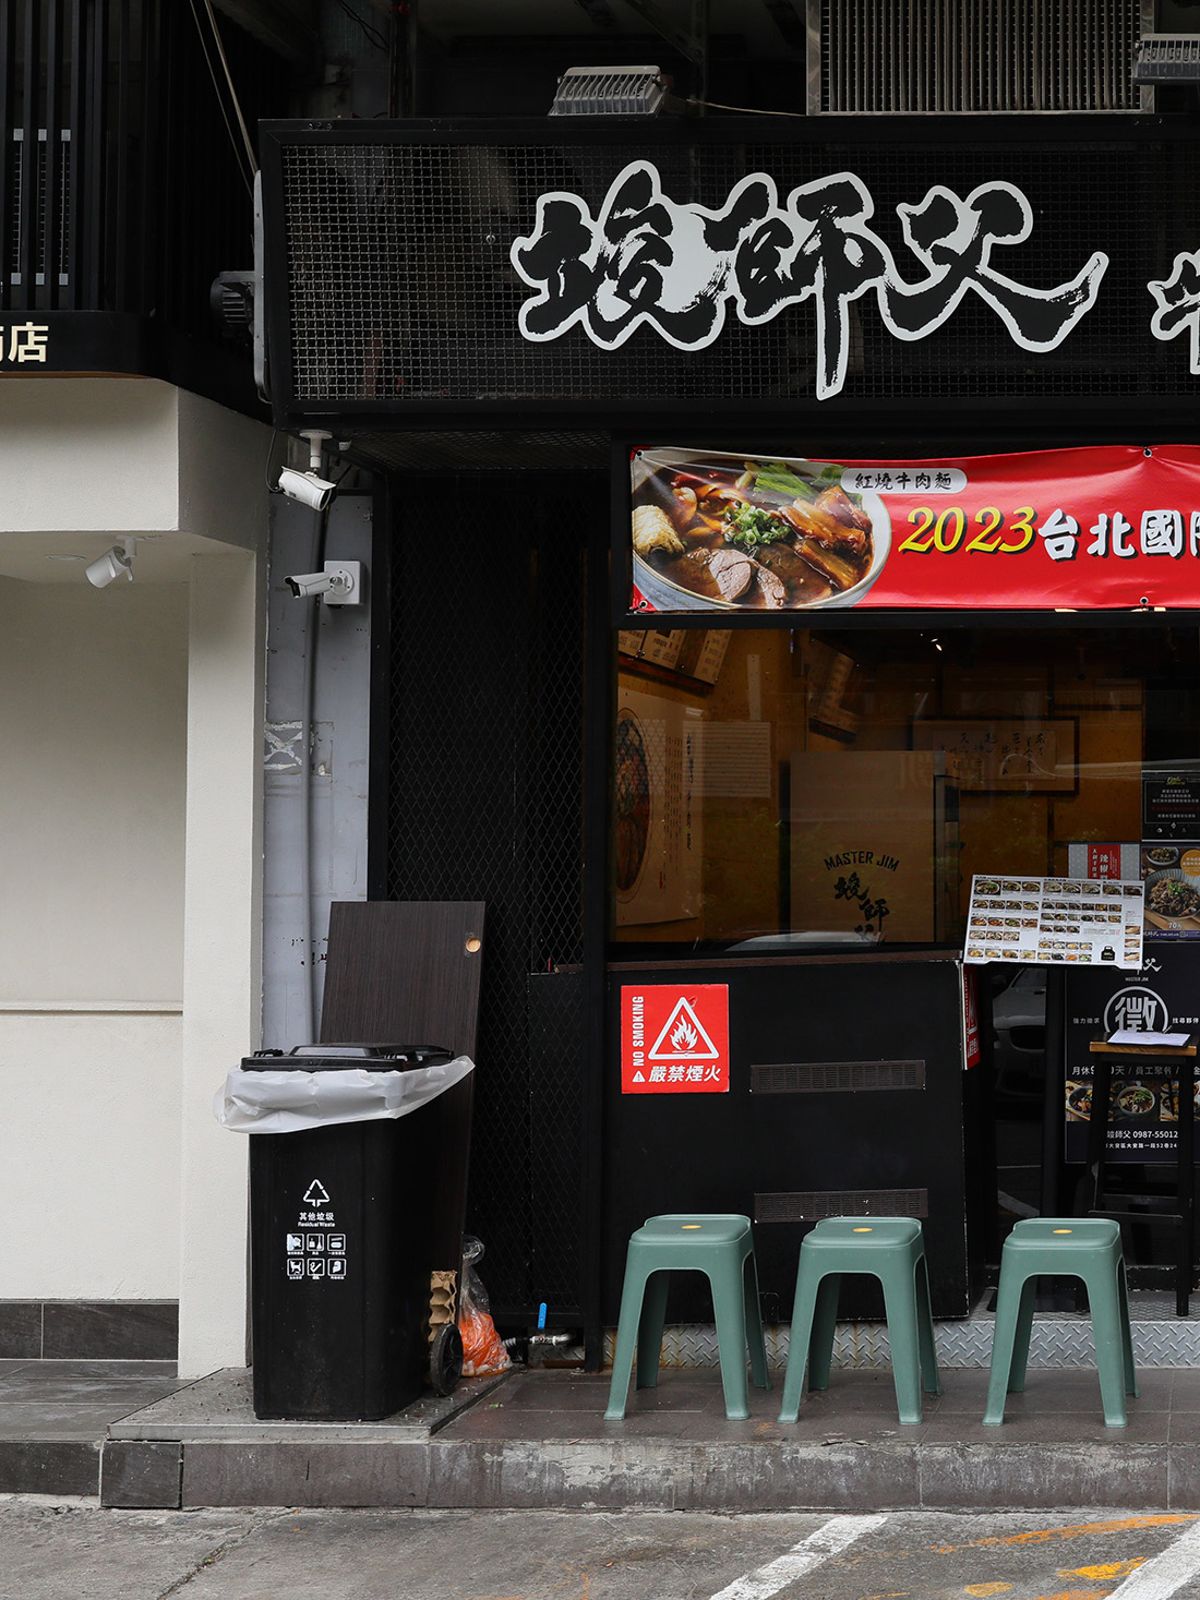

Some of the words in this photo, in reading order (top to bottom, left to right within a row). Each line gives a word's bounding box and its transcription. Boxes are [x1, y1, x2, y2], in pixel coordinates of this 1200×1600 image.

[0, 322, 49, 363] 店
[854, 472, 952, 491] 紅燒牛肉麵
[824, 851, 874, 871] MASTER
[877, 854, 900, 872] JIM
[632, 996, 645, 1047] SMOKING
[1115, 997, 1158, 1033] 徵
[632, 1051, 645, 1066] NO
[648, 1065, 721, 1083] 嚴禁煙火
